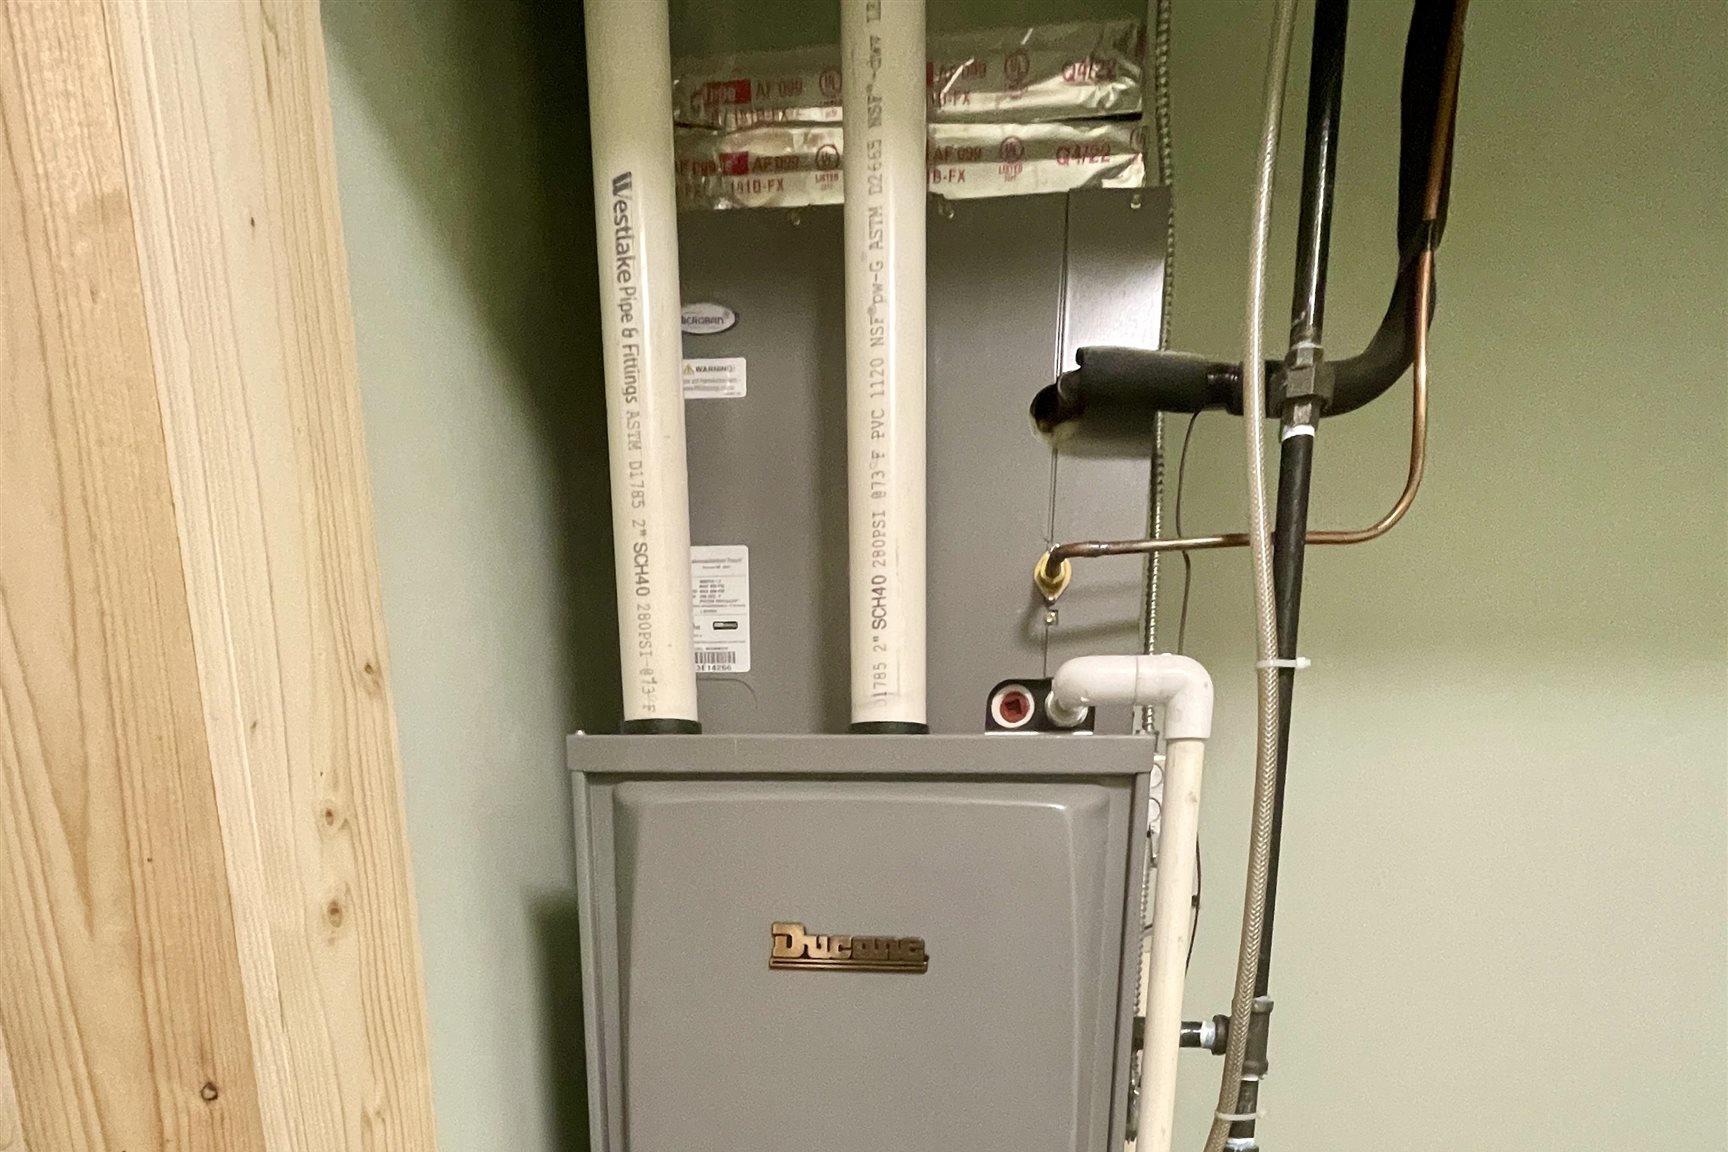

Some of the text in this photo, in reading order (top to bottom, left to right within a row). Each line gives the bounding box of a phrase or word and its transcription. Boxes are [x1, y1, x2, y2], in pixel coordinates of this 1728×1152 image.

[612, 171, 635, 283] Westlake
[868, 206, 883, 250] ASTM
[617, 287, 637, 323] Pipe
[622, 344, 640, 404] Fittings
[870, 358, 885, 398] 1120
[626, 411, 642, 451] ASTM
[871, 408, 885, 440] PVC
[872, 510, 886, 568] 280PSI
[633, 542, 651, 598] SCH40
[871, 574, 887, 630] SCH40
